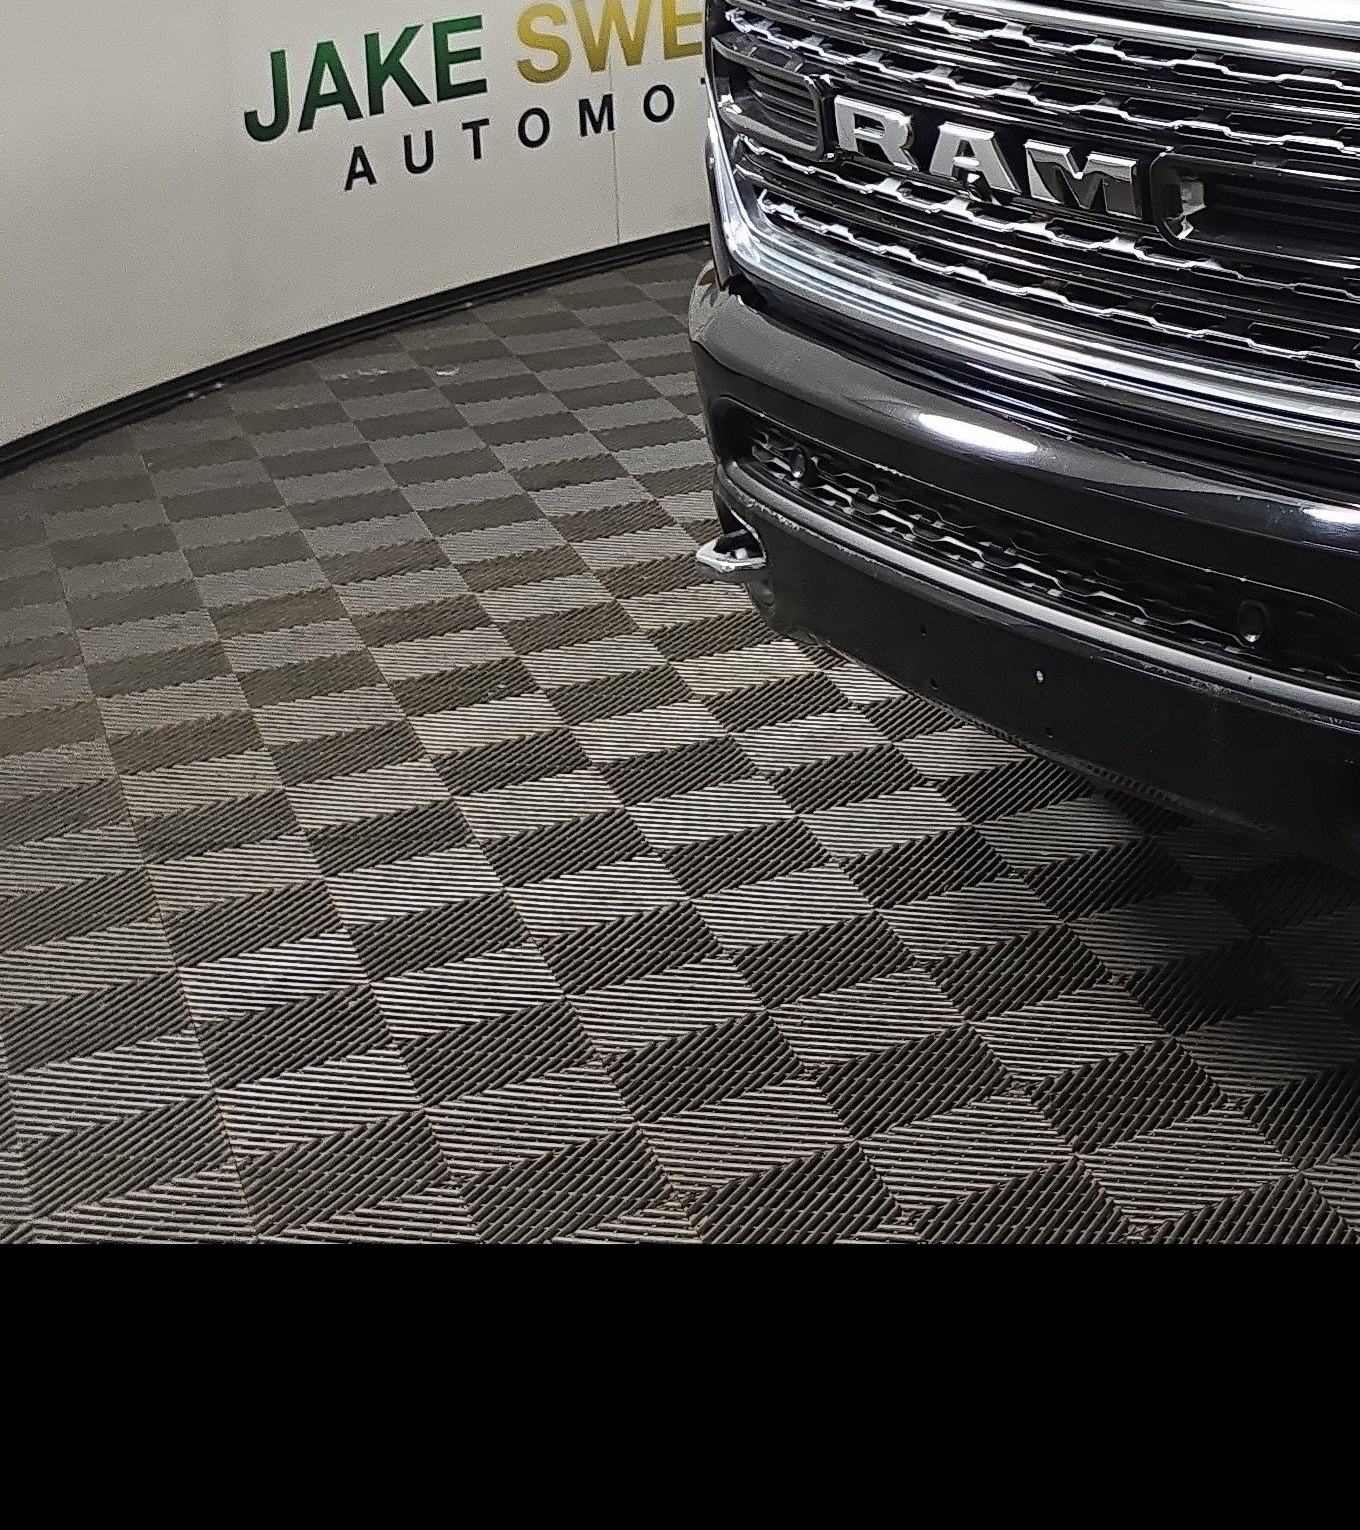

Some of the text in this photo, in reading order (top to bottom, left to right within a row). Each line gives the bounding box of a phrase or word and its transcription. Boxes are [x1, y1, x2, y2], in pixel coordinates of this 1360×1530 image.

[244, 15, 489, 143] JAKE
[343, 76, 704, 191] AUTOMO
[834, 94, 1143, 220] RAM
